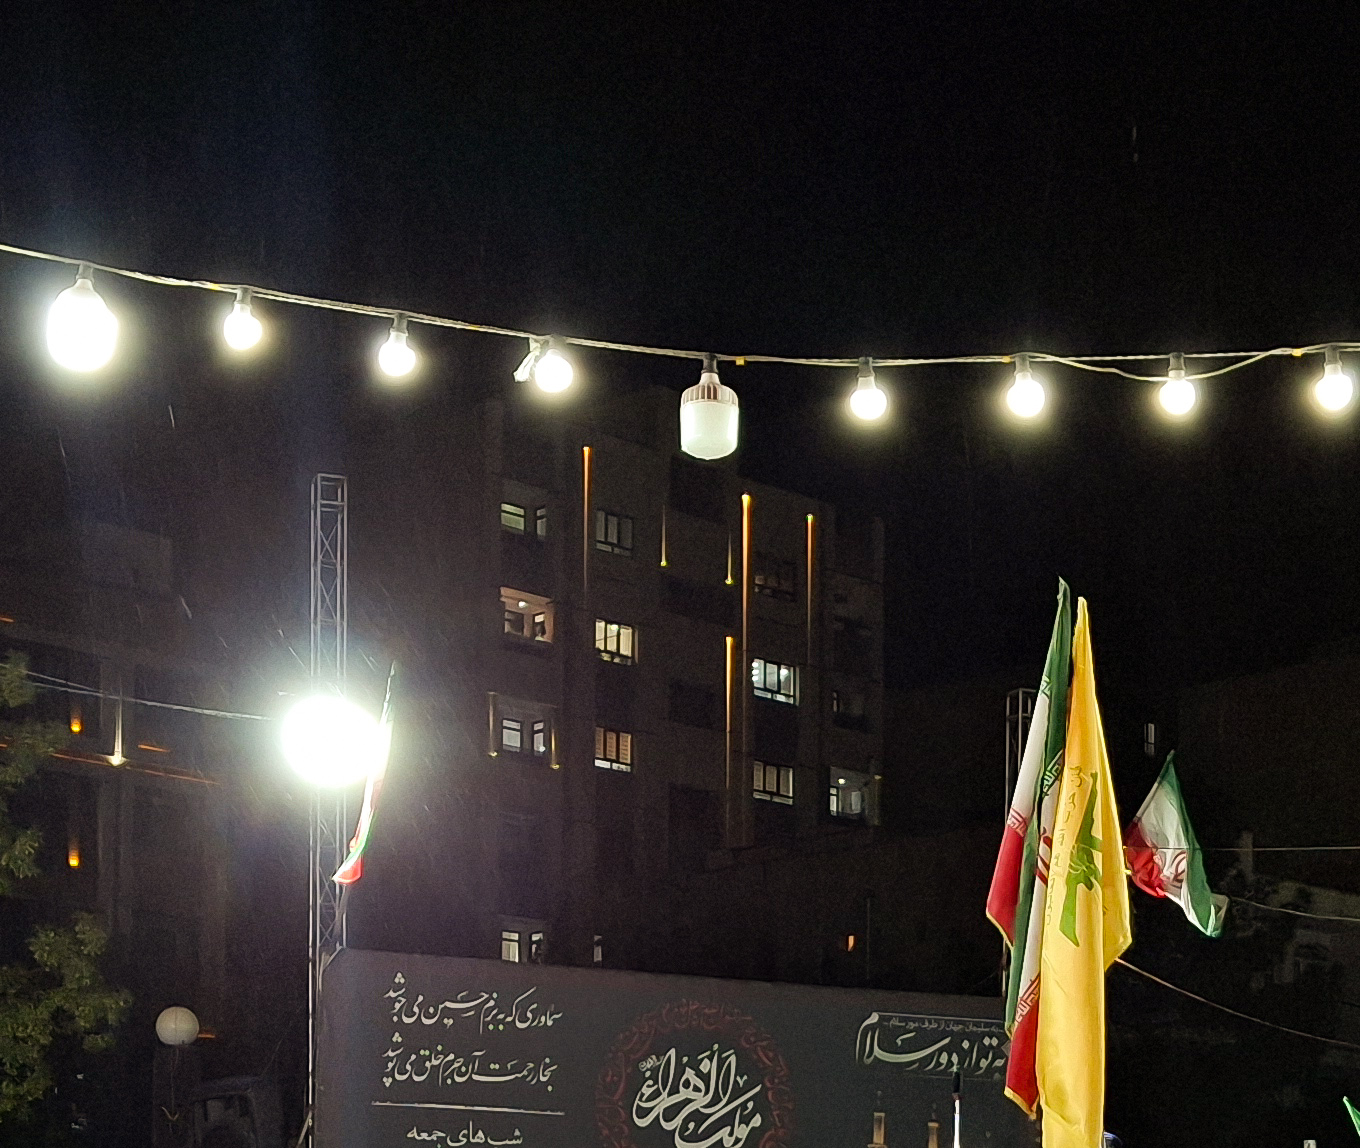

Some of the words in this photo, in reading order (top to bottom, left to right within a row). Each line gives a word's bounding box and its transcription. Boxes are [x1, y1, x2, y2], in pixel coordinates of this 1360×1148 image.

[421, 989, 489, 1029] حسین
[505, 986, 537, 1023] که
[856, 1011, 952, 1071] سلام
[961, 1040, 980, 1069] از
[975, 1036, 999, 1075] تو
[412, 1045, 444, 1082] خلق
[454, 1050, 487, 1083] آن
[406, 1125, 446, 1148] جمعه
